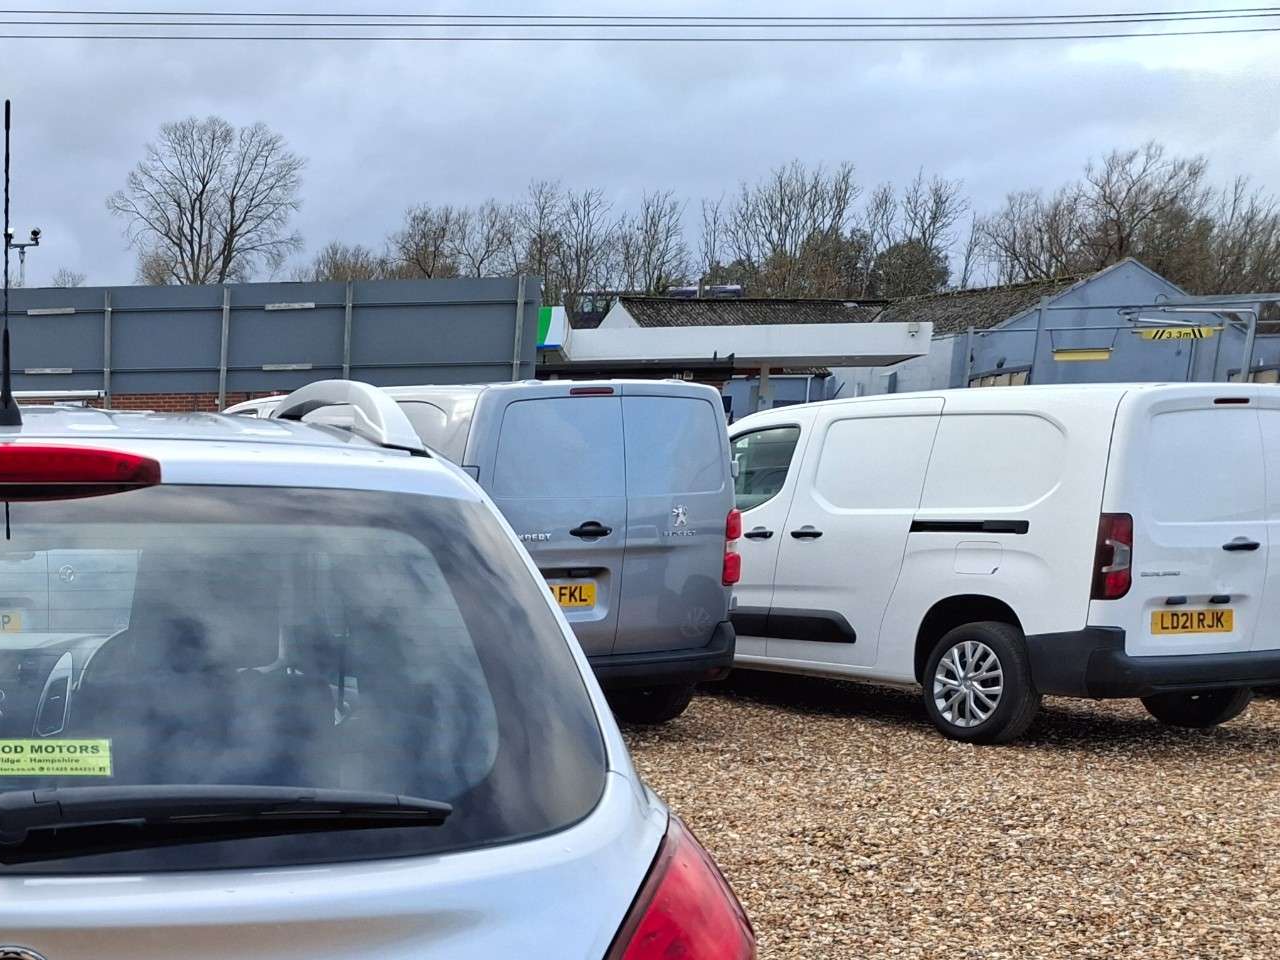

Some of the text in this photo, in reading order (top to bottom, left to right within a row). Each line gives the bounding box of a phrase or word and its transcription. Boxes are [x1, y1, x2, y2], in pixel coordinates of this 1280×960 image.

[558, 586, 588, 603] FKL
[1161, 611, 1225, 630] LD21 RJK
[30, 744, 100, 755] MOTORS
[30, 757, 80, 765] Hampshire
